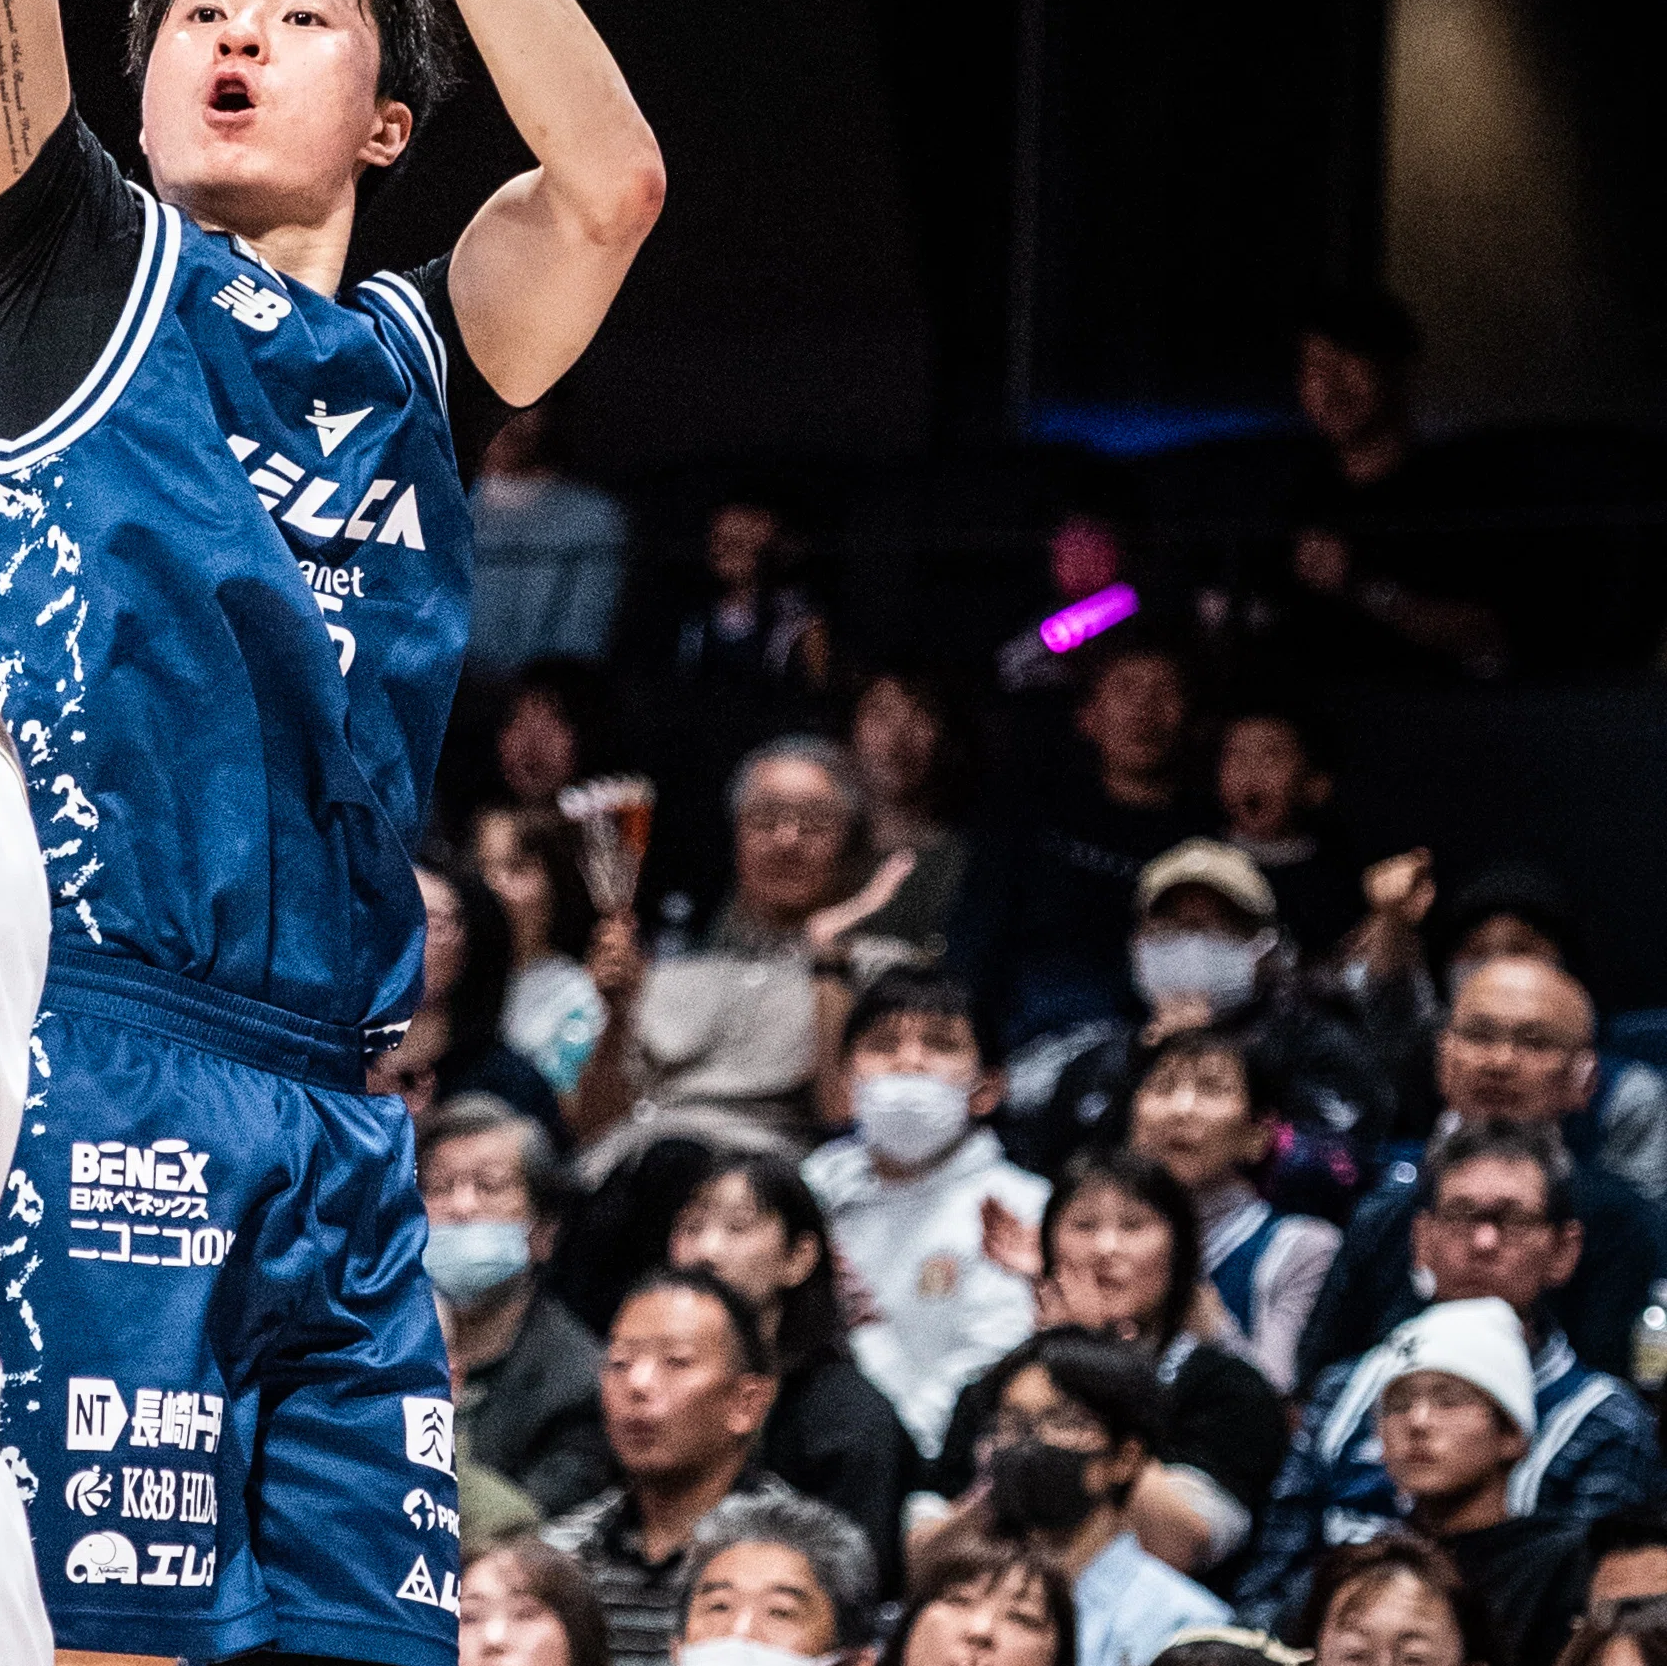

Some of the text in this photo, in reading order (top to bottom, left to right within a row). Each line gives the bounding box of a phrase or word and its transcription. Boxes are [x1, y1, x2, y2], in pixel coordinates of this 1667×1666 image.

[69, 1187, 209, 1220] 日本ベネックス
[76, 1394, 111, 1436] NT
[121, 1467, 176, 1521] K&B
